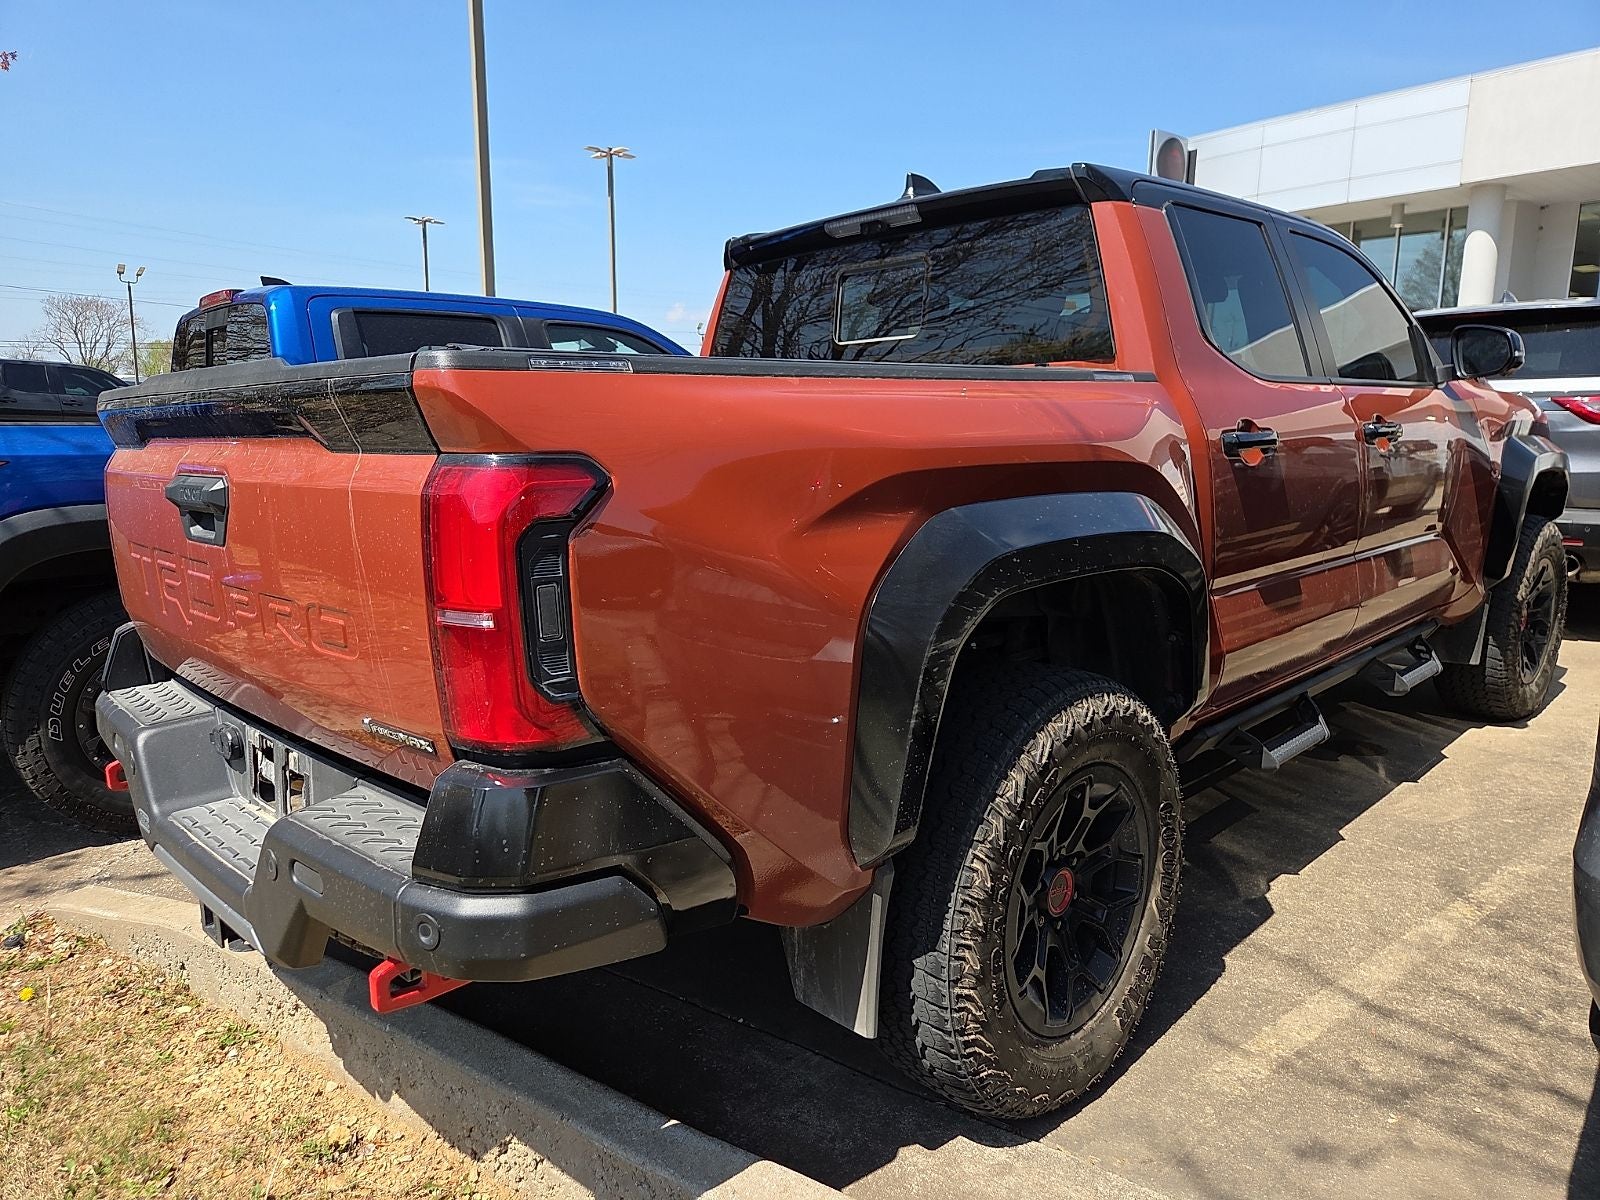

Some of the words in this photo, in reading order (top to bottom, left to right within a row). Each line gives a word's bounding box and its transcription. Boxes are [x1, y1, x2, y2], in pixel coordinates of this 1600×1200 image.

[130, 541, 221, 626] TRD
[221, 581, 360, 660] PRO
[48, 637, 110, 742] DUELE
